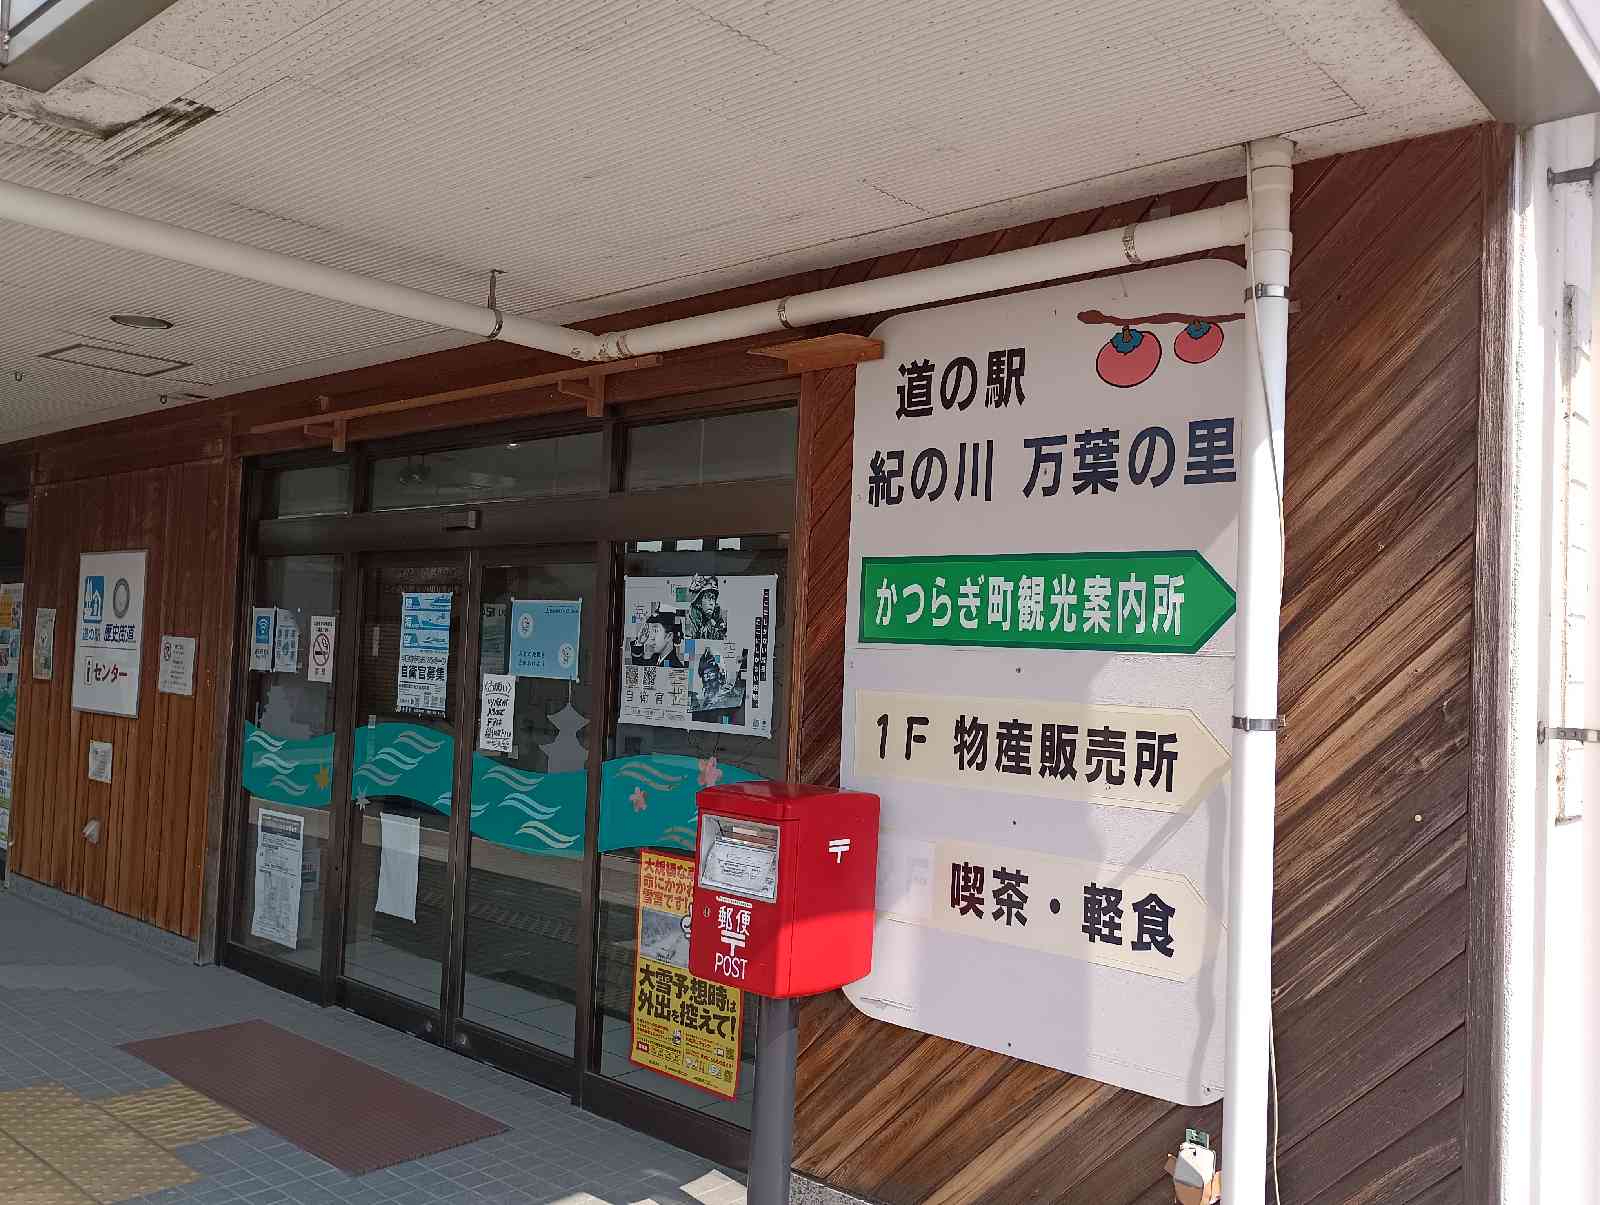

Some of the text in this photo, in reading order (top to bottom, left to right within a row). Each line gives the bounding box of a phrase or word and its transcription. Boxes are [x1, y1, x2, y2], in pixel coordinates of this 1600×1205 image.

[894, 346, 1027, 420] 道の駅
[867, 417, 1237, 508] 紀の川 万葉の里
[875, 572, 1186, 637] かつらぎ町観光案内所
[876, 713, 1180, 793] 1F 物産販売所
[717, 905, 752, 937] 郵便
[950, 861, 1177, 958] 喫茶・軽食
[638, 963, 737, 1013] 大雪予想時は
[714, 952, 748, 980] POST
[637, 988, 737, 1042] 外出を控えて!
